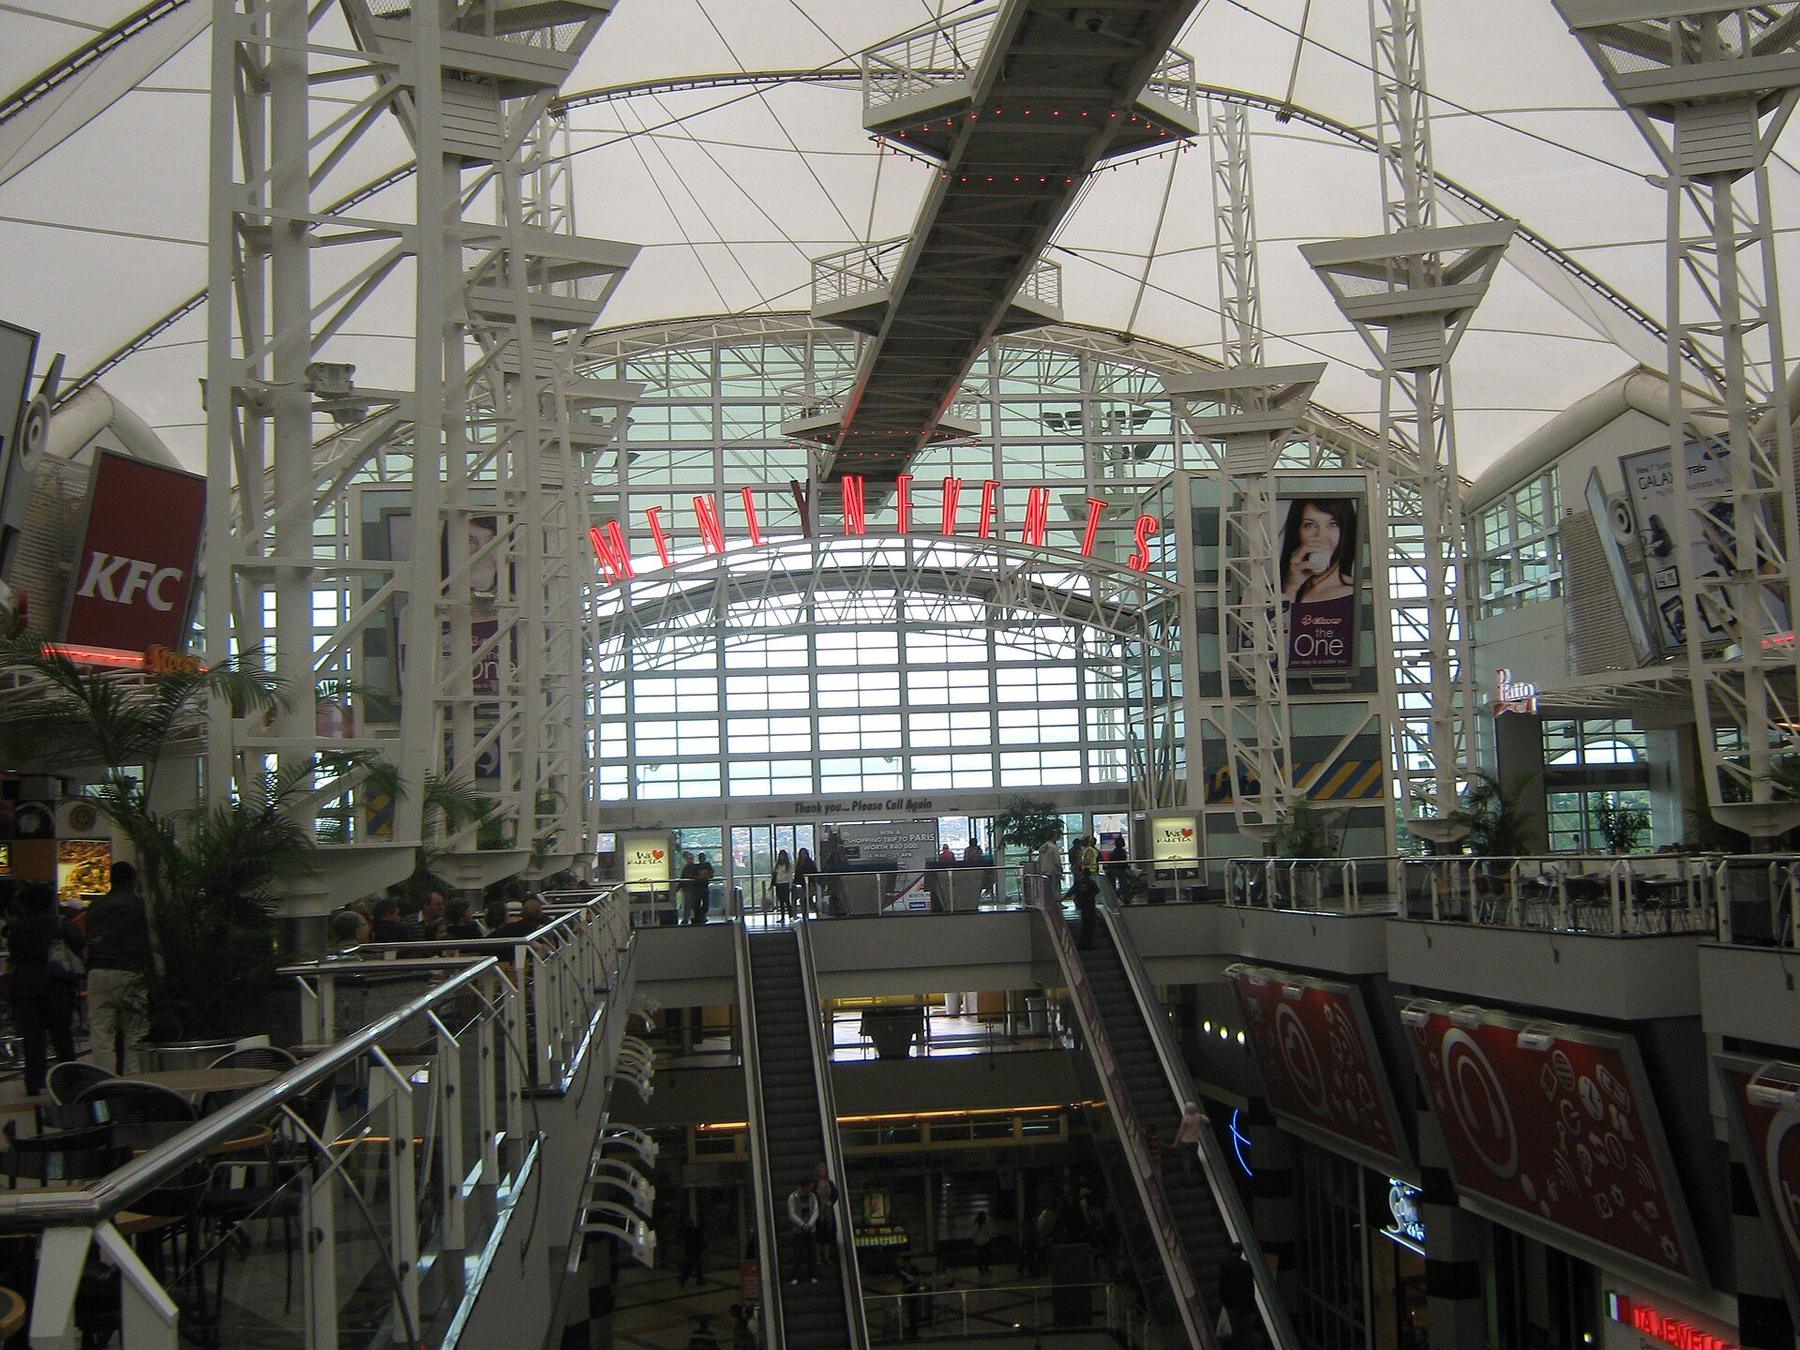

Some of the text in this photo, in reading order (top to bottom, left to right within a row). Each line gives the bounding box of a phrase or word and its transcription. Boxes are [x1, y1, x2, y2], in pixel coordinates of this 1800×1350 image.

[590, 474, 1159, 586] MENLYN EVENTS
[77, 551, 183, 611] KFC
[1315, 628, 1334, 638] the
[1294, 634, 1344, 657] One
[795, 801, 822, 813] Thank
[852, 800, 883, 811] Please
[886, 799, 903, 810] Call
[905, 798, 932, 811] Again
[909, 833, 935, 841] PARIS
